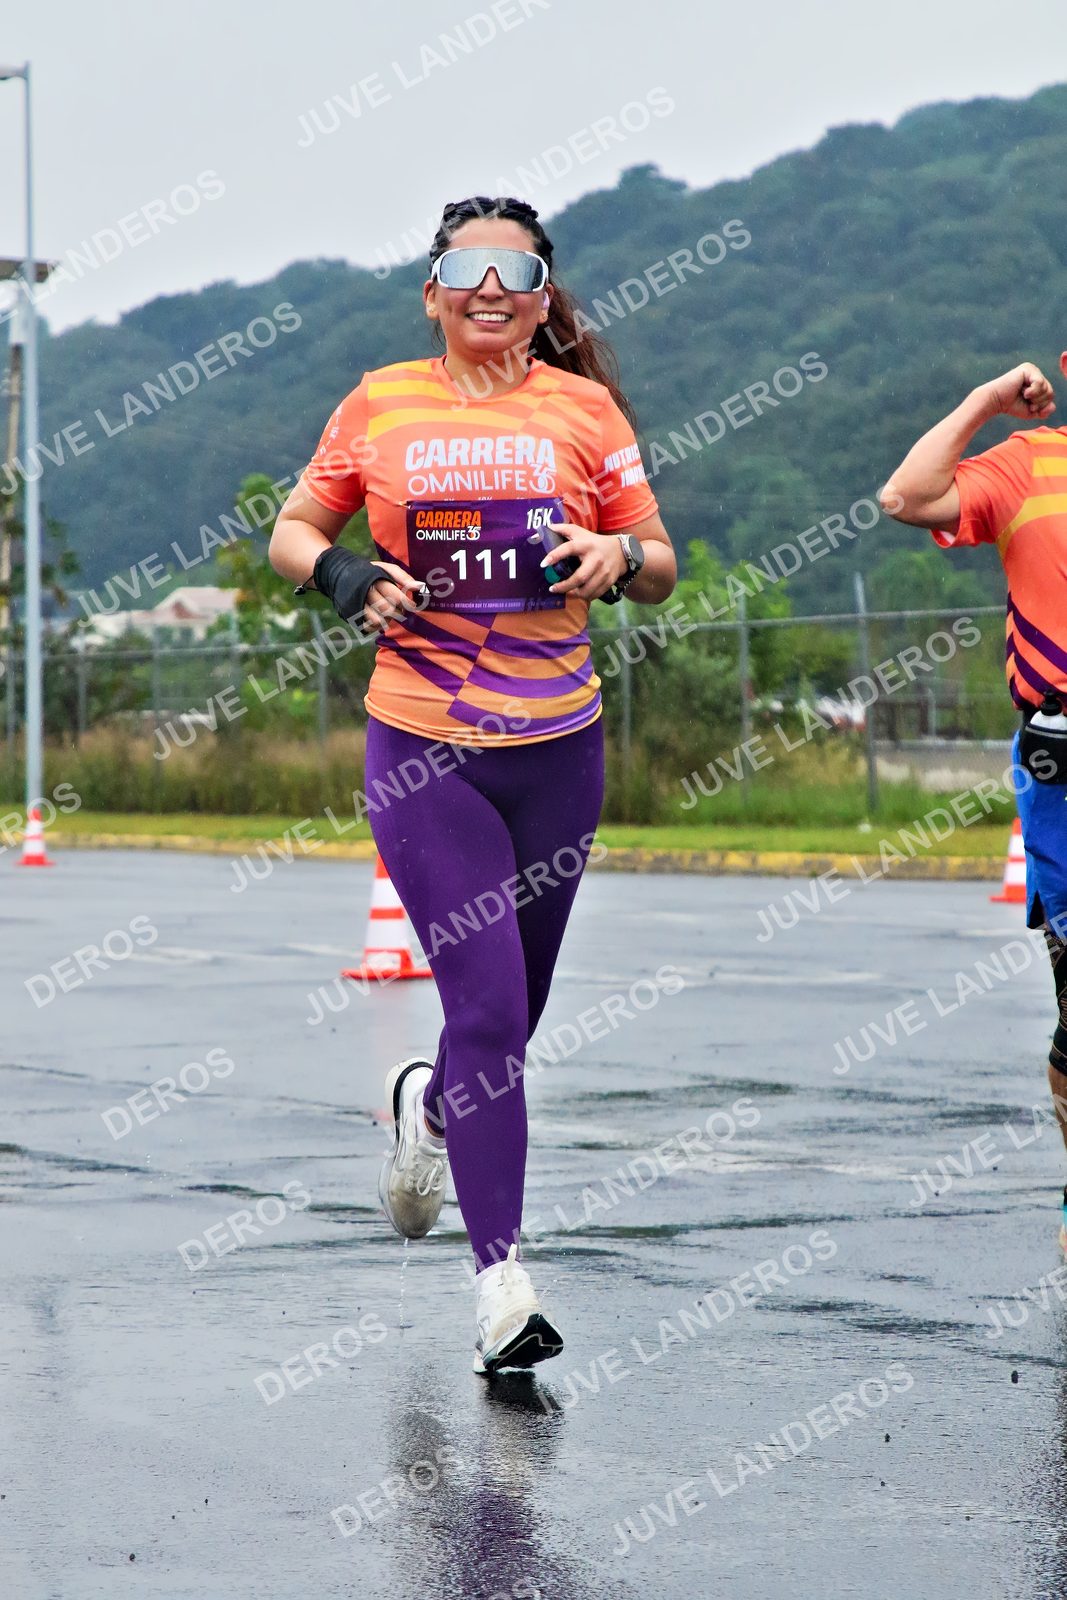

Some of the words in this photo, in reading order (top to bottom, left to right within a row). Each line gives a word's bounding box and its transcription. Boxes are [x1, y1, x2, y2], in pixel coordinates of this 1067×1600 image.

[405, 436, 555, 471] CARRERA
[416, 511, 481, 528] CARRERA
[527, 508, 553, 530] 15K
[451, 549, 517, 580] 111
